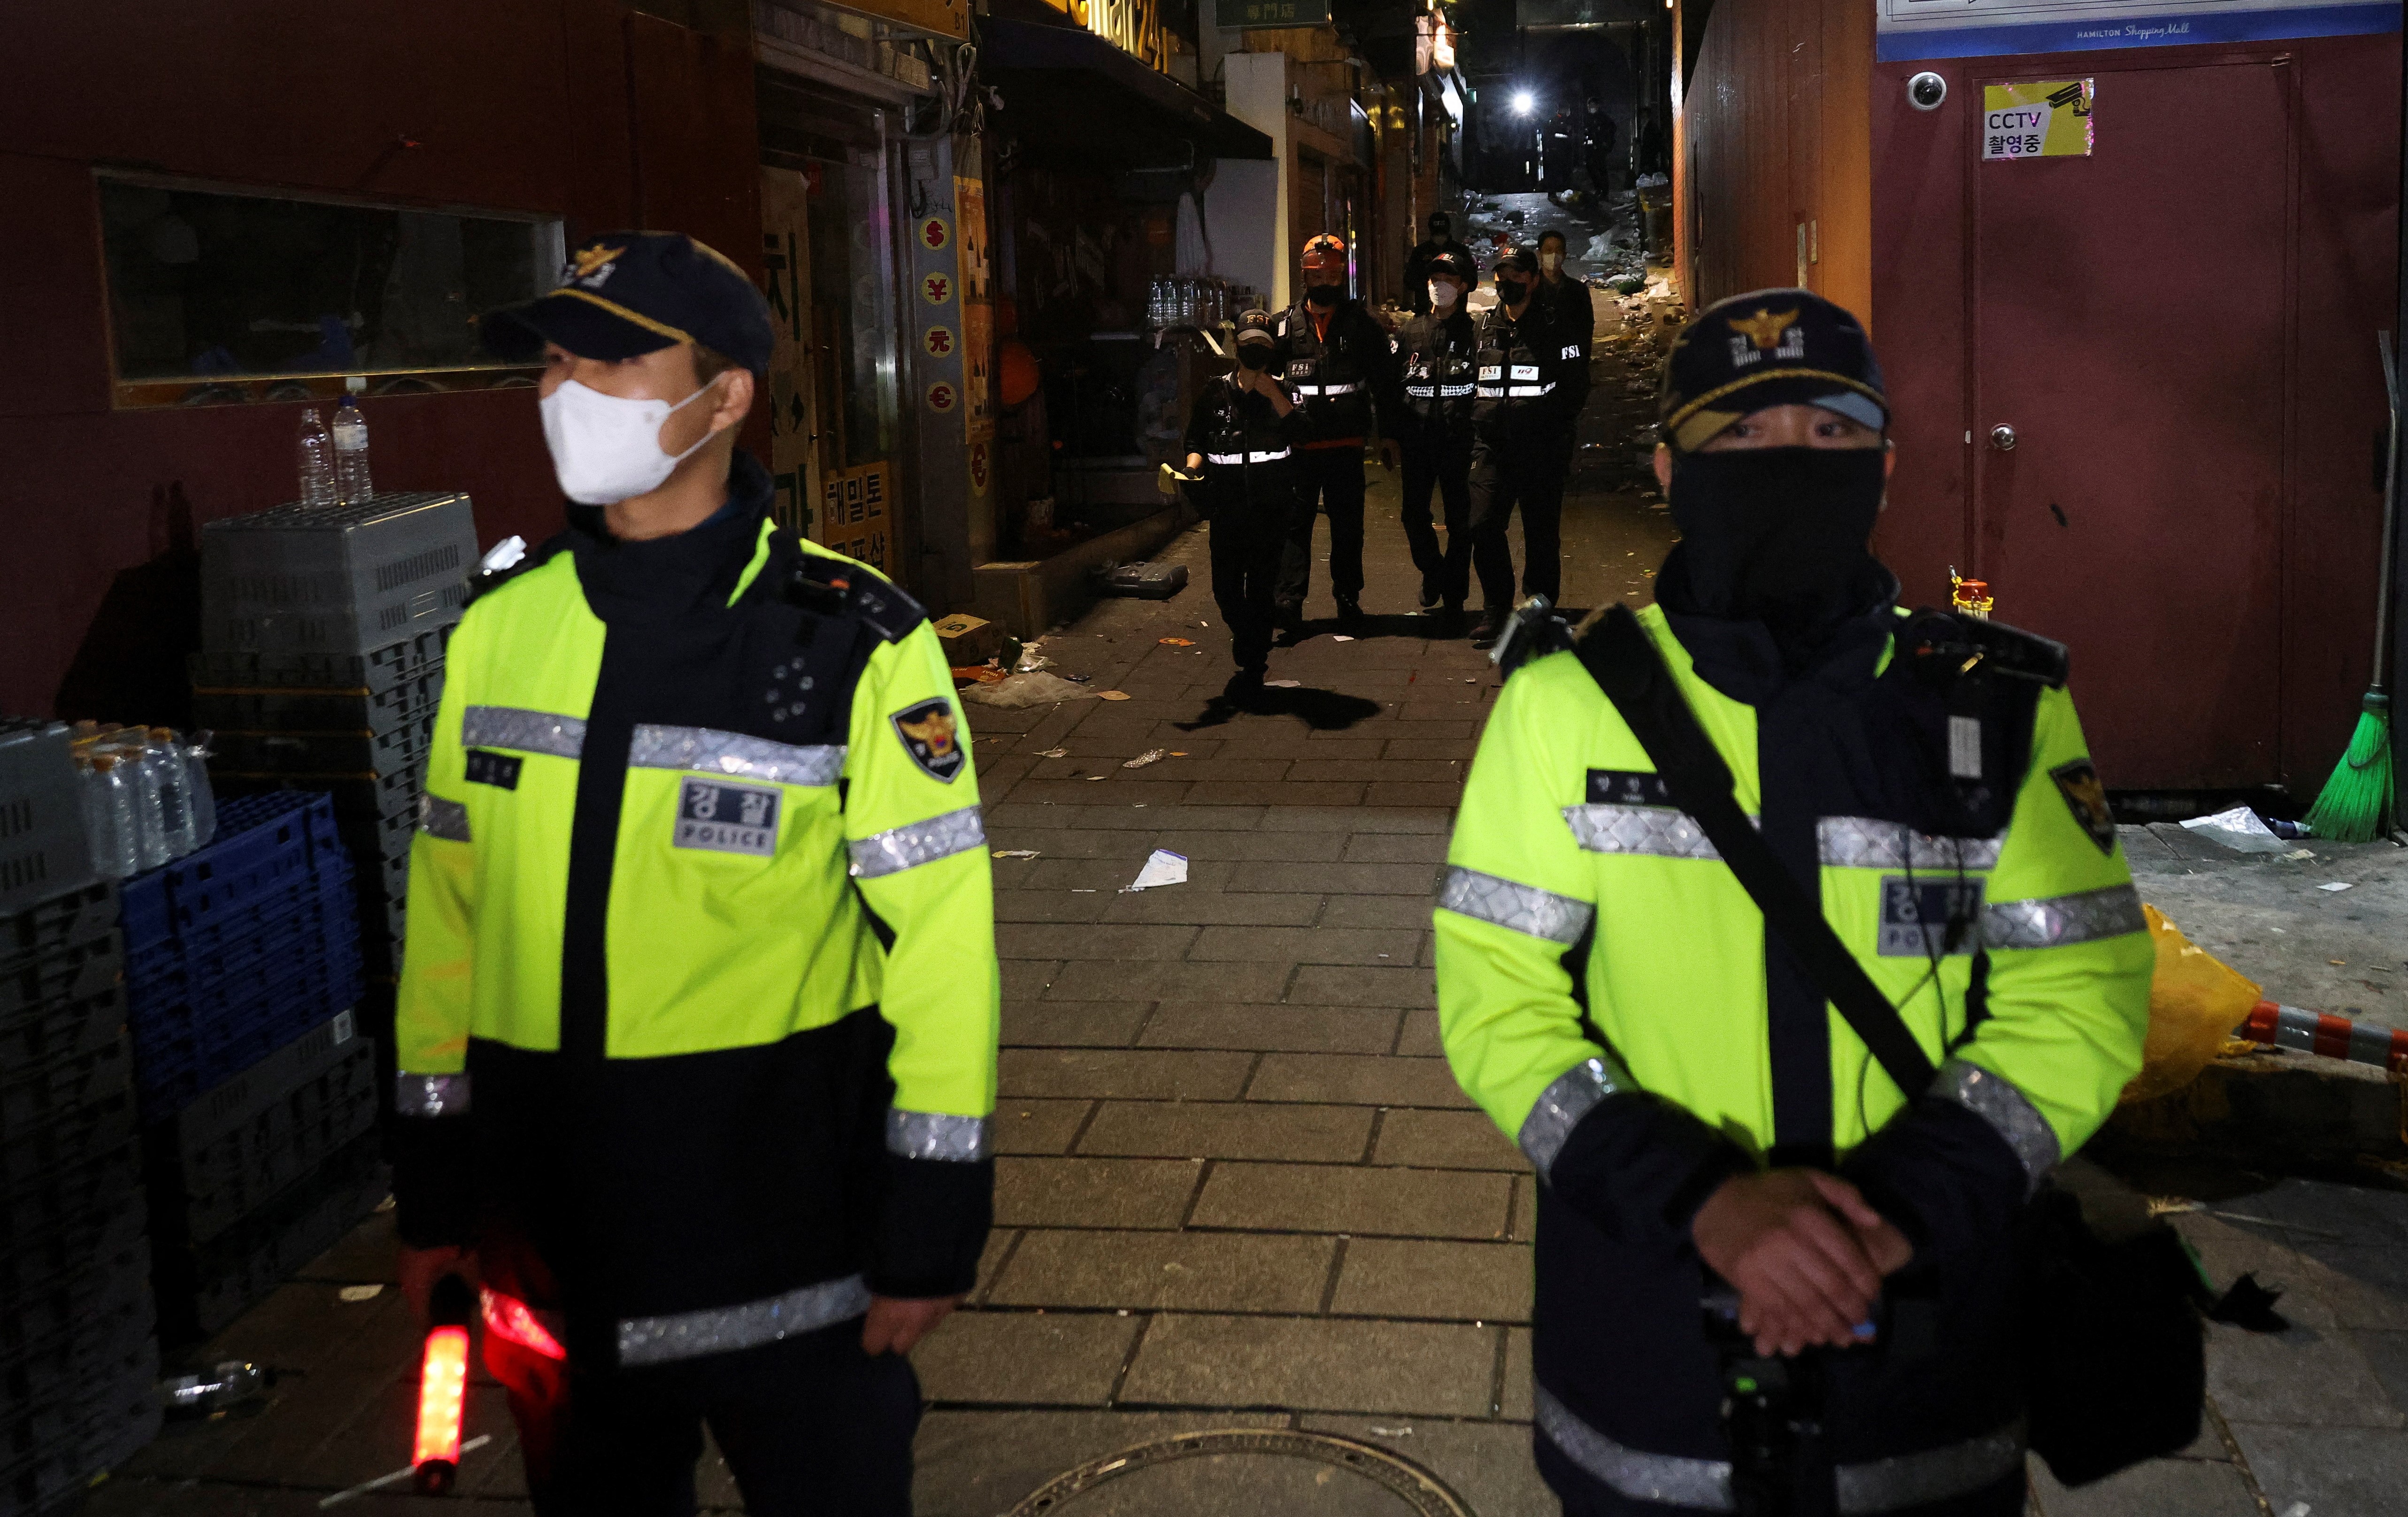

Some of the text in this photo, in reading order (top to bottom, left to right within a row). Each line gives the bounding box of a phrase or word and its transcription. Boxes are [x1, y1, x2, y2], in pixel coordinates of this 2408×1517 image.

[954, 12, 965, 32] B1
[2077, 23, 2190, 39] HAMILTON Shopping Mall
[1989, 112, 2041, 129] CCTV
[1989, 135, 2041, 154] 촬영중
[1246, 315, 1269, 325] FSI
[929, 331, 950, 352] 元
[1561, 345, 1580, 360] FSI
[827, 474, 882, 525] 해밀톤
[684, 823, 765, 848] POLICE
